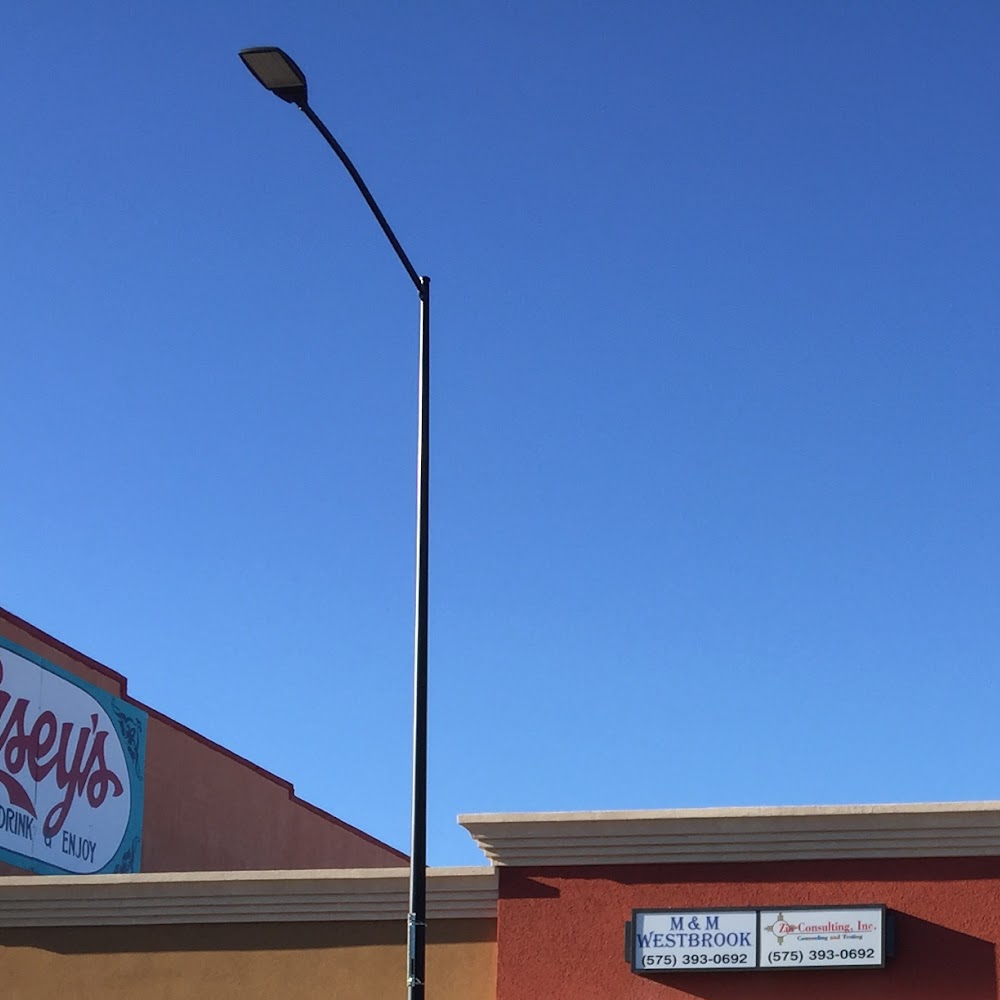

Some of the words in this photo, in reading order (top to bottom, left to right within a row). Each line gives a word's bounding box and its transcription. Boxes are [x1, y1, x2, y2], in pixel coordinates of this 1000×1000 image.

[0, 688, 123, 837] sey's
[62, 830, 97, 864] ENJOY
[670, 916, 683, 931] M
[687, 916, 700, 930] &
[705, 916, 719, 930] M
[798, 921, 853, 933] Consulting,
[857, 920, 877, 931] Inc.
[636, 932, 752, 949] WESTBROOK
[641, 954, 678, 967] (575)
[682, 953, 748, 965] 393-0692
[768, 950, 804, 963] (575)
[809, 948, 875, 961] 393-0692
